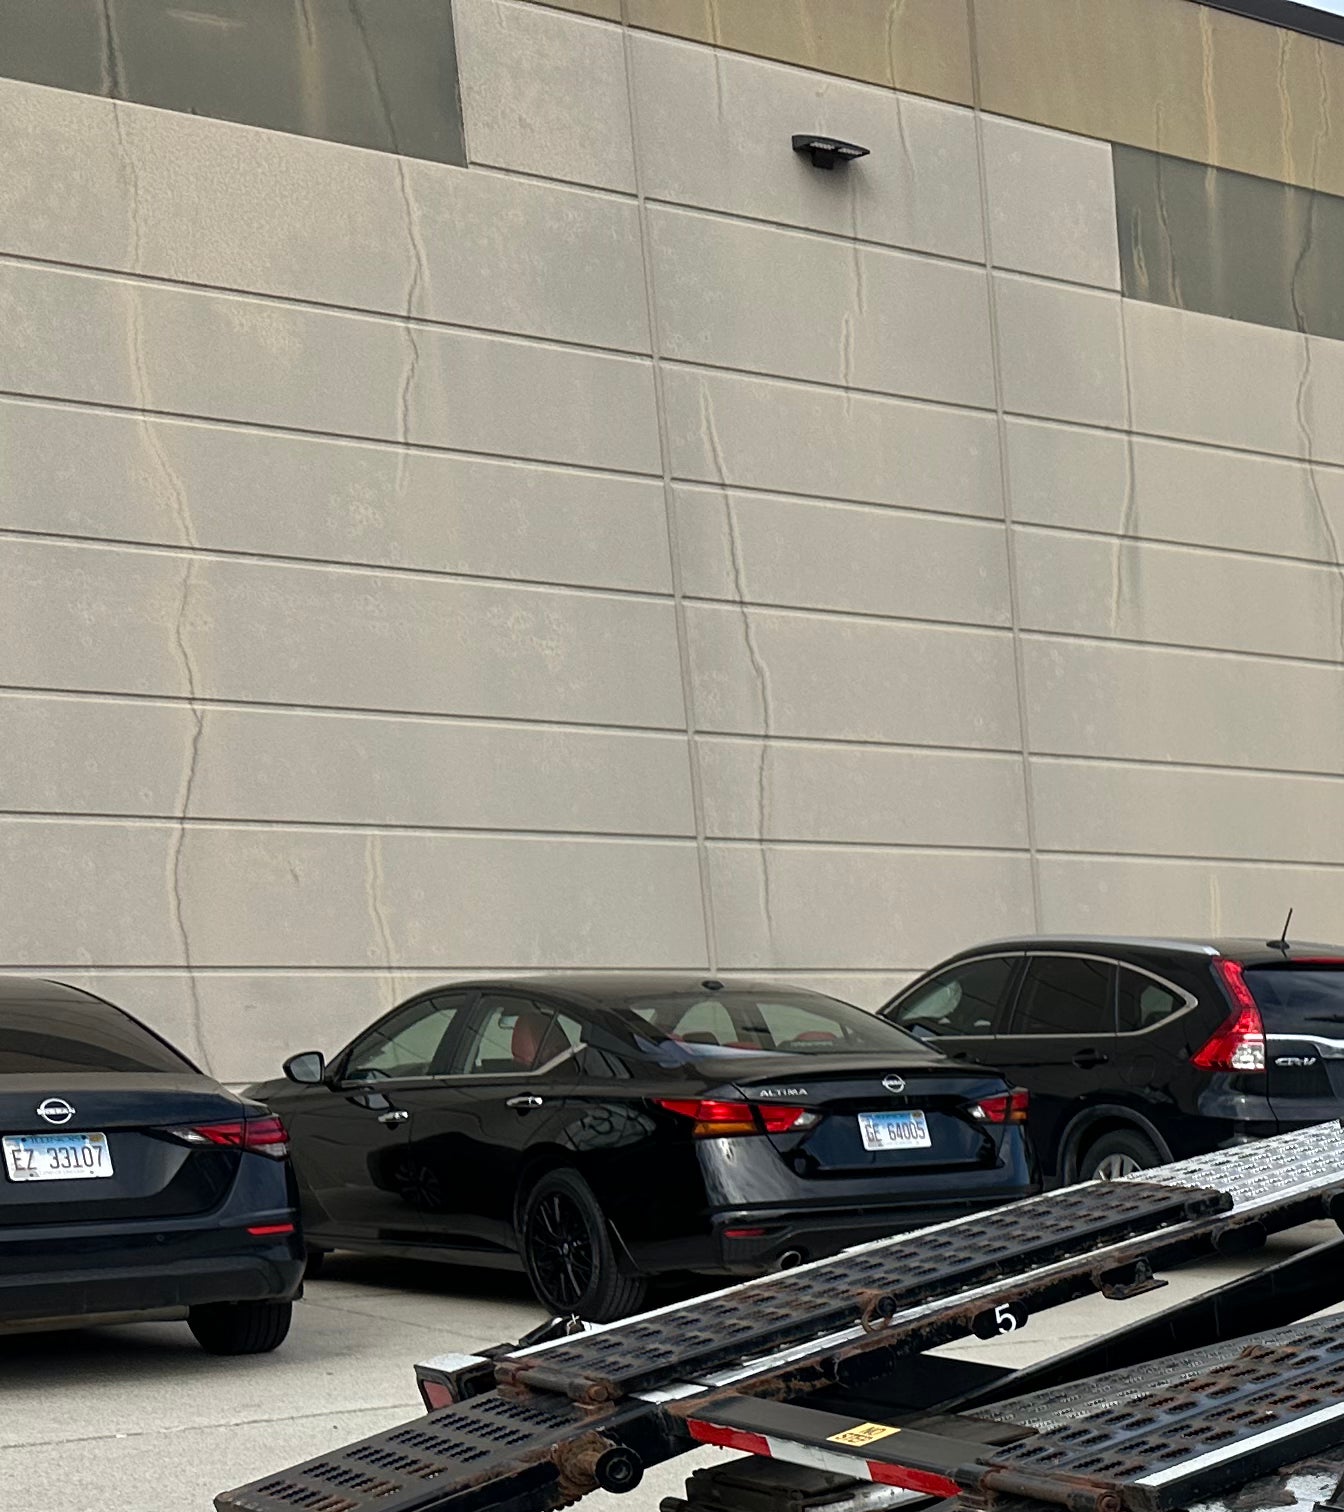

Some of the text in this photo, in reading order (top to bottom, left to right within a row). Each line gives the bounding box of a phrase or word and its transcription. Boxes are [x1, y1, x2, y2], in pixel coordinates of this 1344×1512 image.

[760, 1088, 808, 1097] ALTIMA
[887, 1120, 926, 1141] 64005
[12, 1146, 102, 1171] EZ 33107
[995, 1303, 1017, 1334] 5
